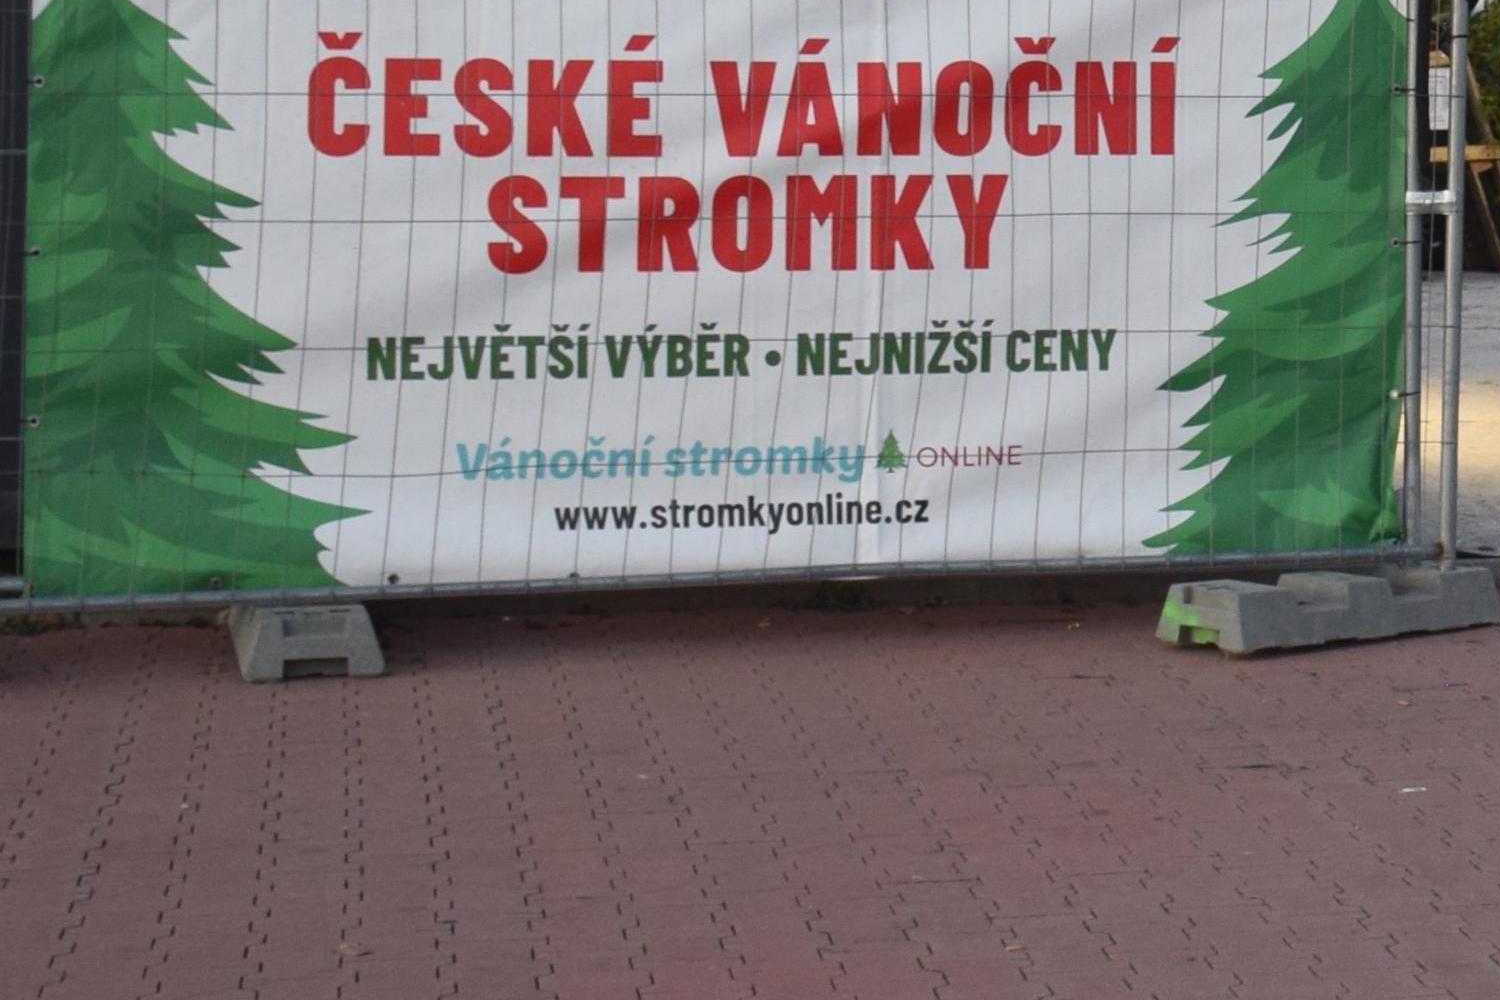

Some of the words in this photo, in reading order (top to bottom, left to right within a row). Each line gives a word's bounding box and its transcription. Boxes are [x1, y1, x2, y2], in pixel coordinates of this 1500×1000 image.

[307, 31, 664, 158] ČESKÉ
[709, 36, 1182, 158] VÁNOČNÍ
[487, 174, 1009, 275] STROMKY
[365, 323, 591, 380] NEJVĚTŠÍ
[605, 322, 750, 378] VÝBĚR
[797, 319, 995, 376] NEJNIŽŠÍ
[1005, 328, 1117, 374] CENY
[456, 434, 654, 482] Vánoční
[664, 435, 866, 485] stromky
[916, 445, 1023, 469] ONLINE
[554, 493, 929, 535] www.stromkyonline.cz
